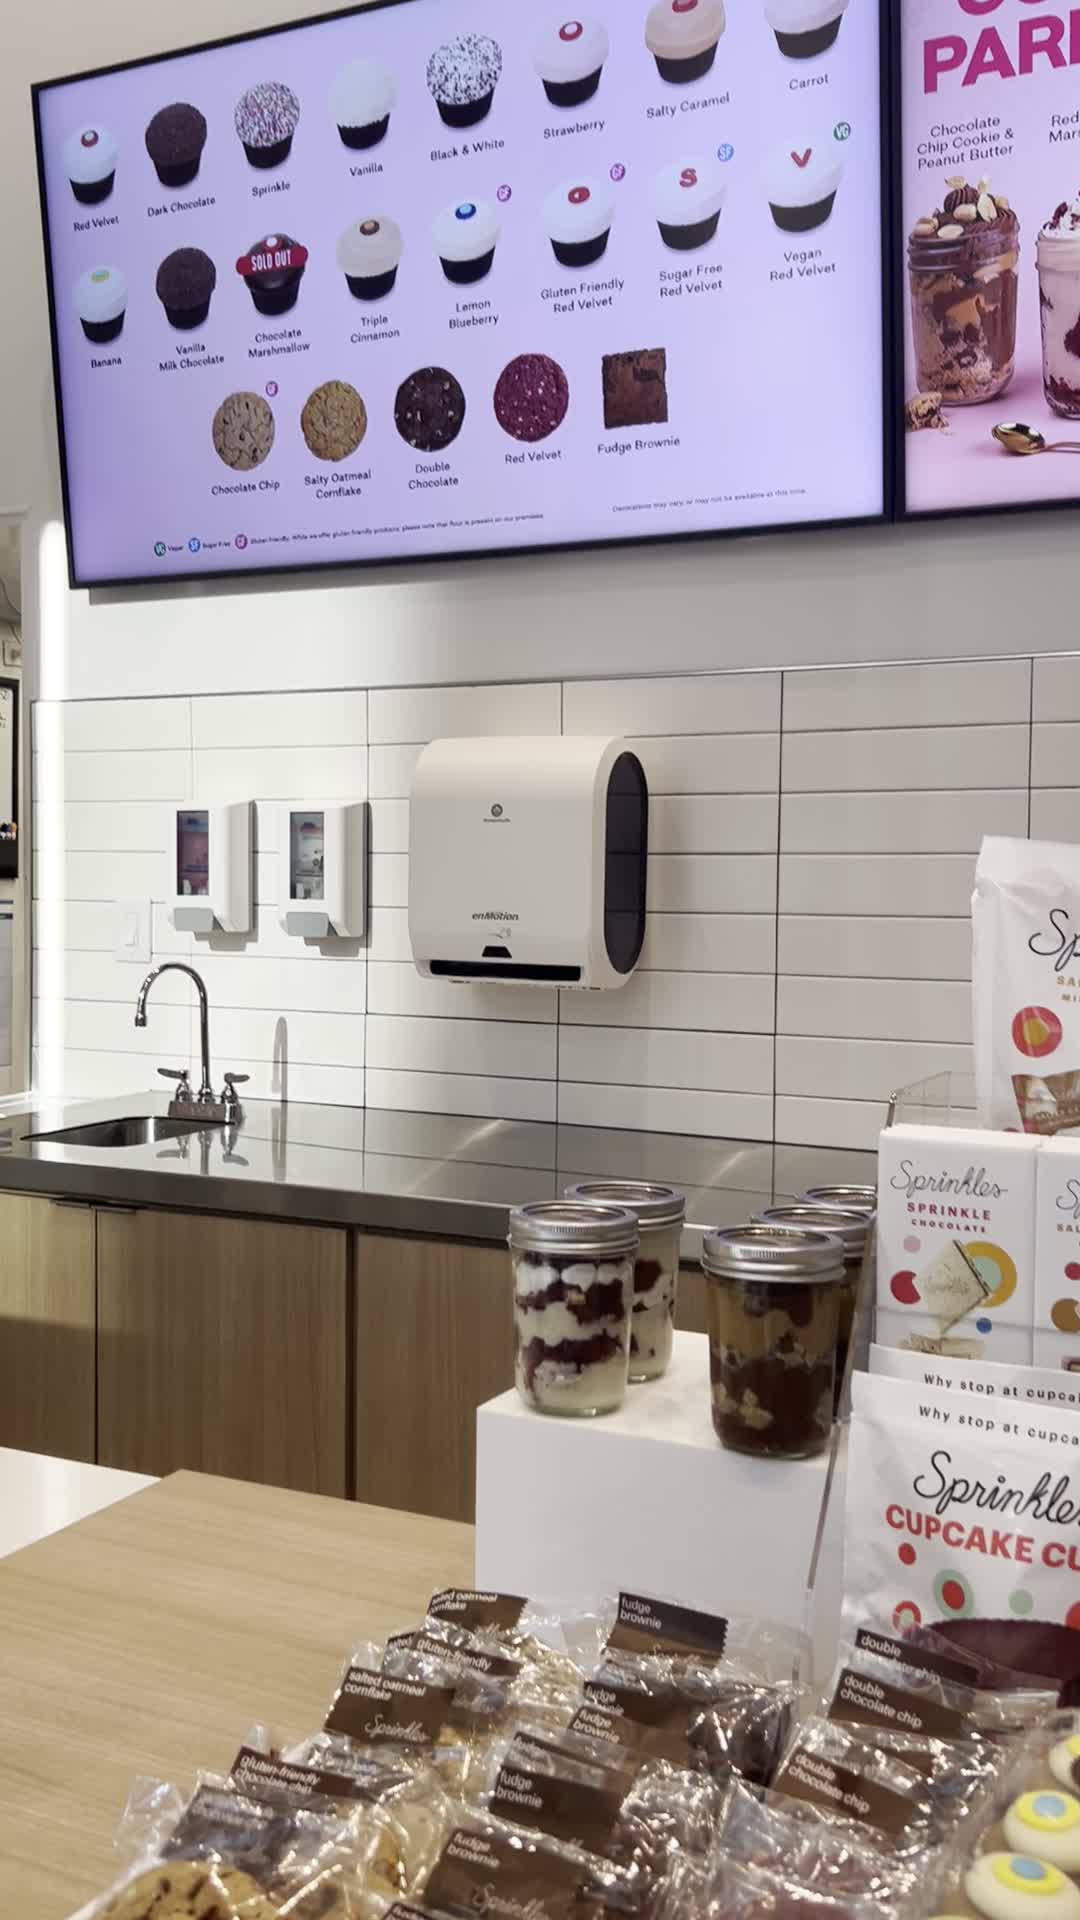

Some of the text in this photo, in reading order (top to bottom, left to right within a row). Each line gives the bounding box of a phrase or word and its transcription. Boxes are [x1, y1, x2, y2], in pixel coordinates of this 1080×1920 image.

[789, 74, 829, 90] Carrot
[646, 92, 730, 119] Salty Caramel
[930, 117, 1000, 138] Chocolate
[1051, 111, 1080, 127] Red
[543, 120, 605, 139] Strawberry
[430, 139, 505, 161] Black & White
[917, 128, 1015, 155] Chip Cookie &
[918, 145, 1015, 170] Peanut Butter
[349, 163, 383, 177] Vanilla
[252, 181, 290, 197] Sprinkle
[147, 196, 216, 217] Dark Chocolate
[73, 215, 119, 232] Red Velvet
[251, 250, 292, 271] SOLD OUT
[784, 249, 822, 264] Vegan
[659, 264, 723, 283] Sugar Free
[770, 263, 836, 281] Red Velvet
[541, 279, 625, 300] Gluten Friendly
[660, 280, 722, 298] Red Velvet
[456, 300, 491, 313] Lemon
[553, 296, 613, 313] Red Velvet
[361, 314, 388, 327] Triple
[449, 314, 499, 329] Blueberry
[255, 329, 302, 344] Chocolate
[351, 329, 400, 344] Cinnamon
[176, 343, 206, 355] Vanilla
[248, 342, 310, 358] Marshmallow
[91, 357, 122, 369] Banana
[159, 355, 224, 371] Milk Chocolate
[597, 436, 680, 455] Fudge Brownie
[505, 449, 562, 465] Red Velvet
[415, 461, 450, 474] Double
[304, 469, 372, 486] Salty Oatmeal
[408, 476, 459, 490] Chocolate
[211, 480, 280, 496] Chocolate Chip
[316, 487, 361, 499] Cornflake
[472, 911, 519, 922] enMotion
[1057, 976, 1080, 988] SA
[1062, 993, 1080, 1003] MI
[890, 1160, 1008, 1199] Sprinkles
[907, 1202, 992, 1221] SPRINKLE
[912, 1218, 986, 1233] CHOCOLATE
[924, 1373, 953, 1389] Why
[960, 1380, 995, 1396] stop
[1003, 1386, 1018, 1397] at
[919, 1405, 950, 1423] Why
[958, 1413, 995, 1431] stop
[1003, 1422, 1019, 1435] at
[885, 1503, 1034, 1564] CUPCAKE
[456, 1591, 498, 1602] oatmeal
[621, 1596, 651, 1614] fudge
[620, 1609, 662, 1630] brownie
[861, 1634, 902, 1656] double
[417, 1639, 492, 1672] gluten-friendly
[344, 1684, 392, 1701] cornflake
[349, 1670, 427, 1697] salted oatmeal
[844, 1675, 885, 1700] double
[586, 1686, 617, 1703] fudge
[840, 1687, 922, 1729] chocolate chip
[579, 1709, 612, 1728] fudge
[573, 1721, 620, 1744] brownie
[240, 1755, 321, 1786] gluten-friendly
[795, 1753, 836, 1780] double
[500, 1770, 533, 1790] fudge
[495, 1786, 543, 1809] brownie
[788, 1766, 870, 1814] chocolate chip
[453, 1831, 492, 1853] fudge
[447, 1844, 500, 1870] brownie
